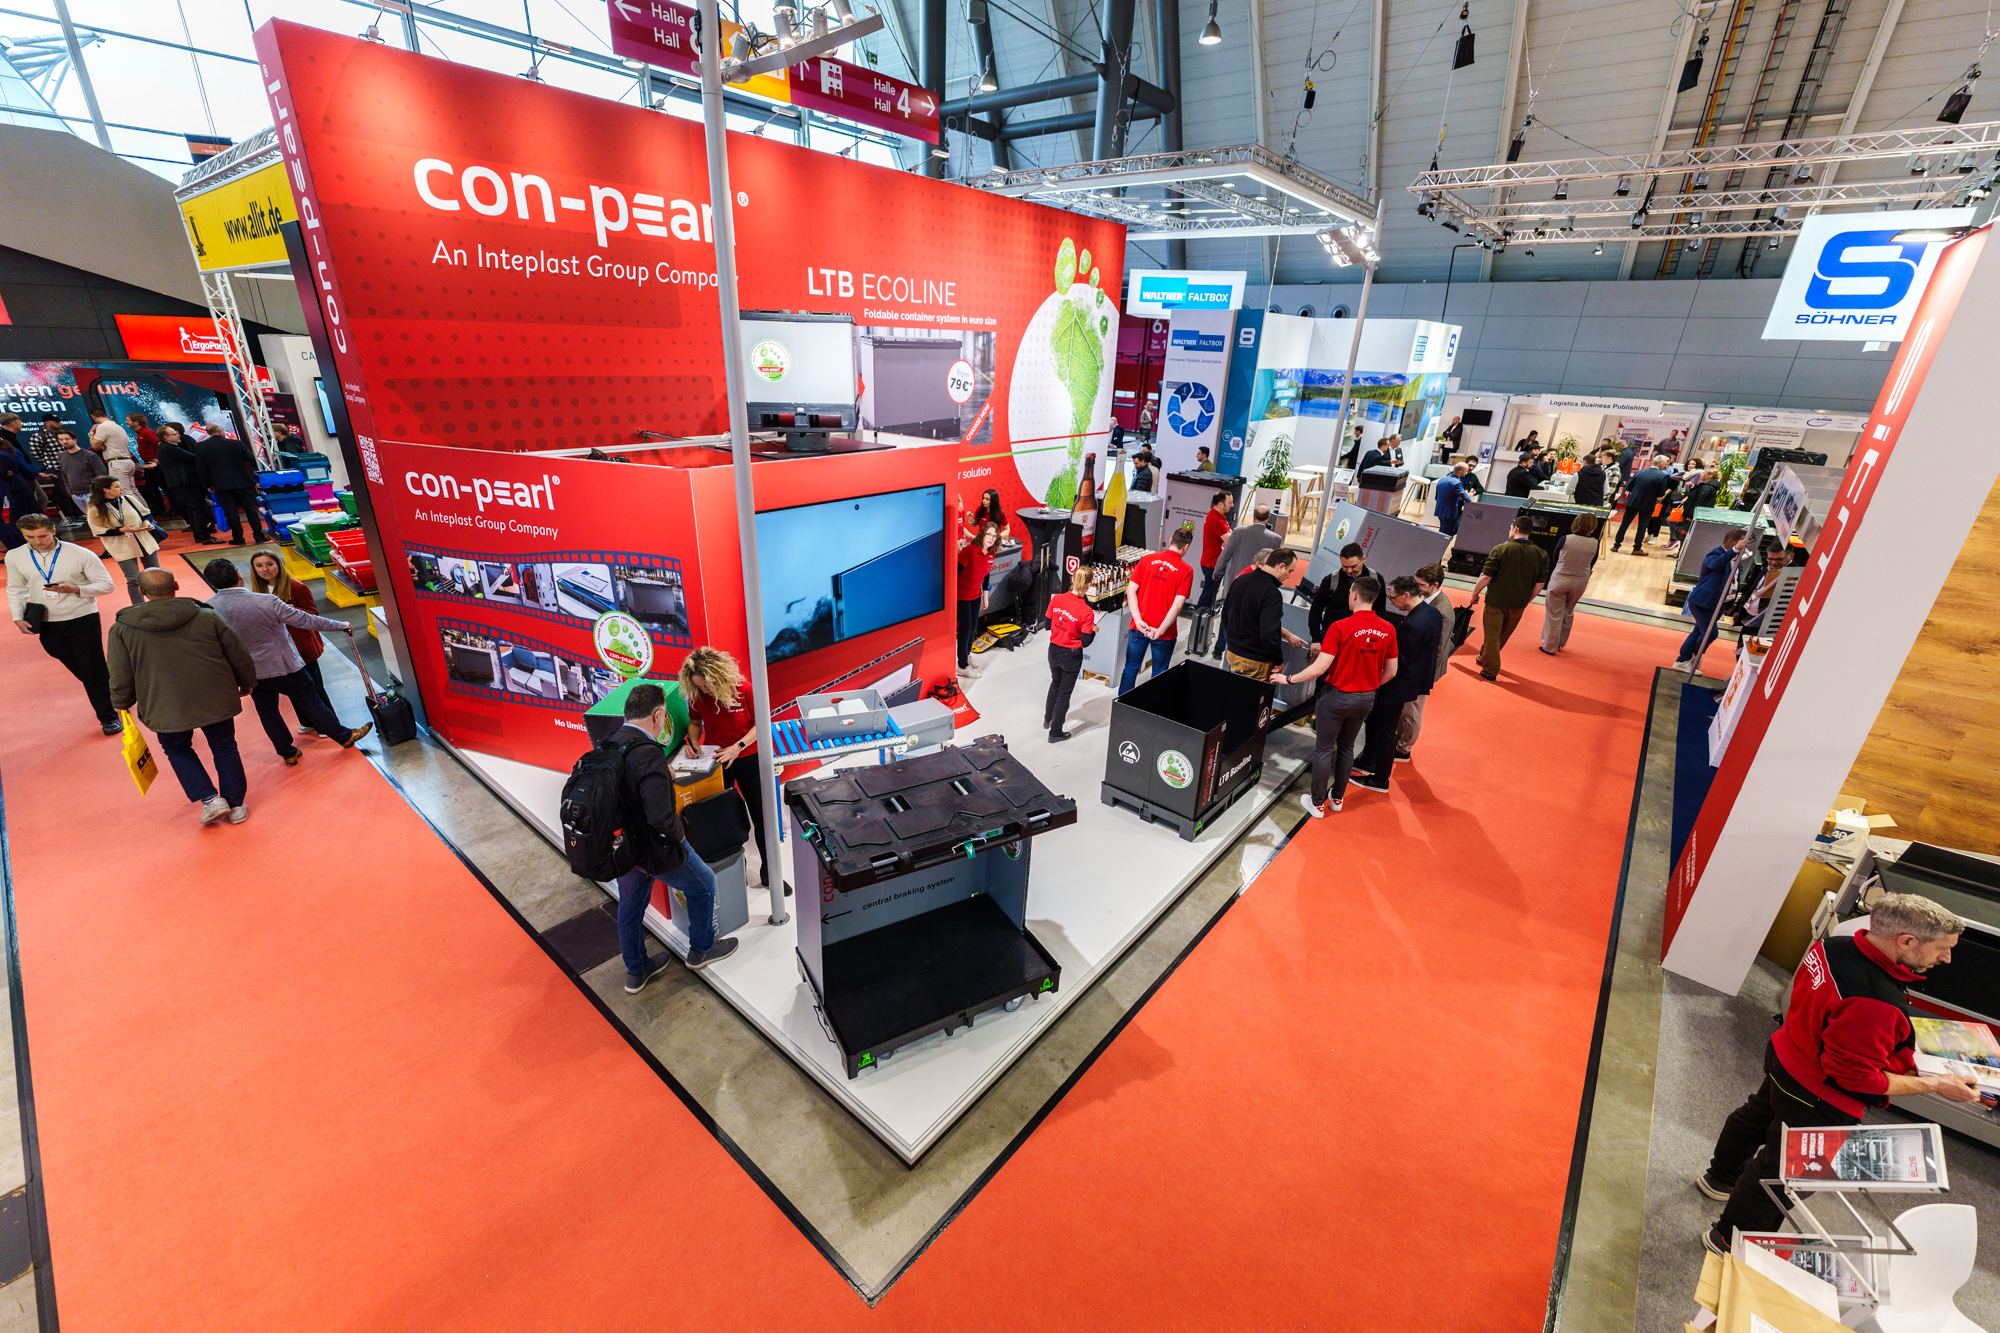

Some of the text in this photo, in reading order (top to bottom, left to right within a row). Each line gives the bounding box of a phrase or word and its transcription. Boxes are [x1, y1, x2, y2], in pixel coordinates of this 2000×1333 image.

[651, 2, 686, 28] Halle
[653, 26, 681, 49] Hall
[873, 77, 912, 118] Halle 4
[873, 97, 892, 114] Hall
[432, 239, 467, 266] An
[477, 243, 580, 278] Inteplast
[586, 254, 650, 287] Group
[807, 266, 957, 307] LTB ECOLINE
[1188, 292, 1229, 302] FALTBOX
[864, 308, 997, 326] Foldable container system in euro size
[1794, 311, 1898, 326] SÖHNER
[1198, 339, 1224, 347] FALTBOX
[58, 381, 140, 399] geund
[1549, 399, 1650, 412] Logistics Business Publishing
[965, 402, 991, 441] CHANGE NOW
[962, 466, 992, 479] solution
[415, 508, 559, 541] An Inteplast Group Company
[554, 718, 587, 732] No limits
[1123, 755, 1135, 765] ESD
[1218, 754, 1252, 787] LTB Baseline
[862, 876, 956, 910] central braking system
